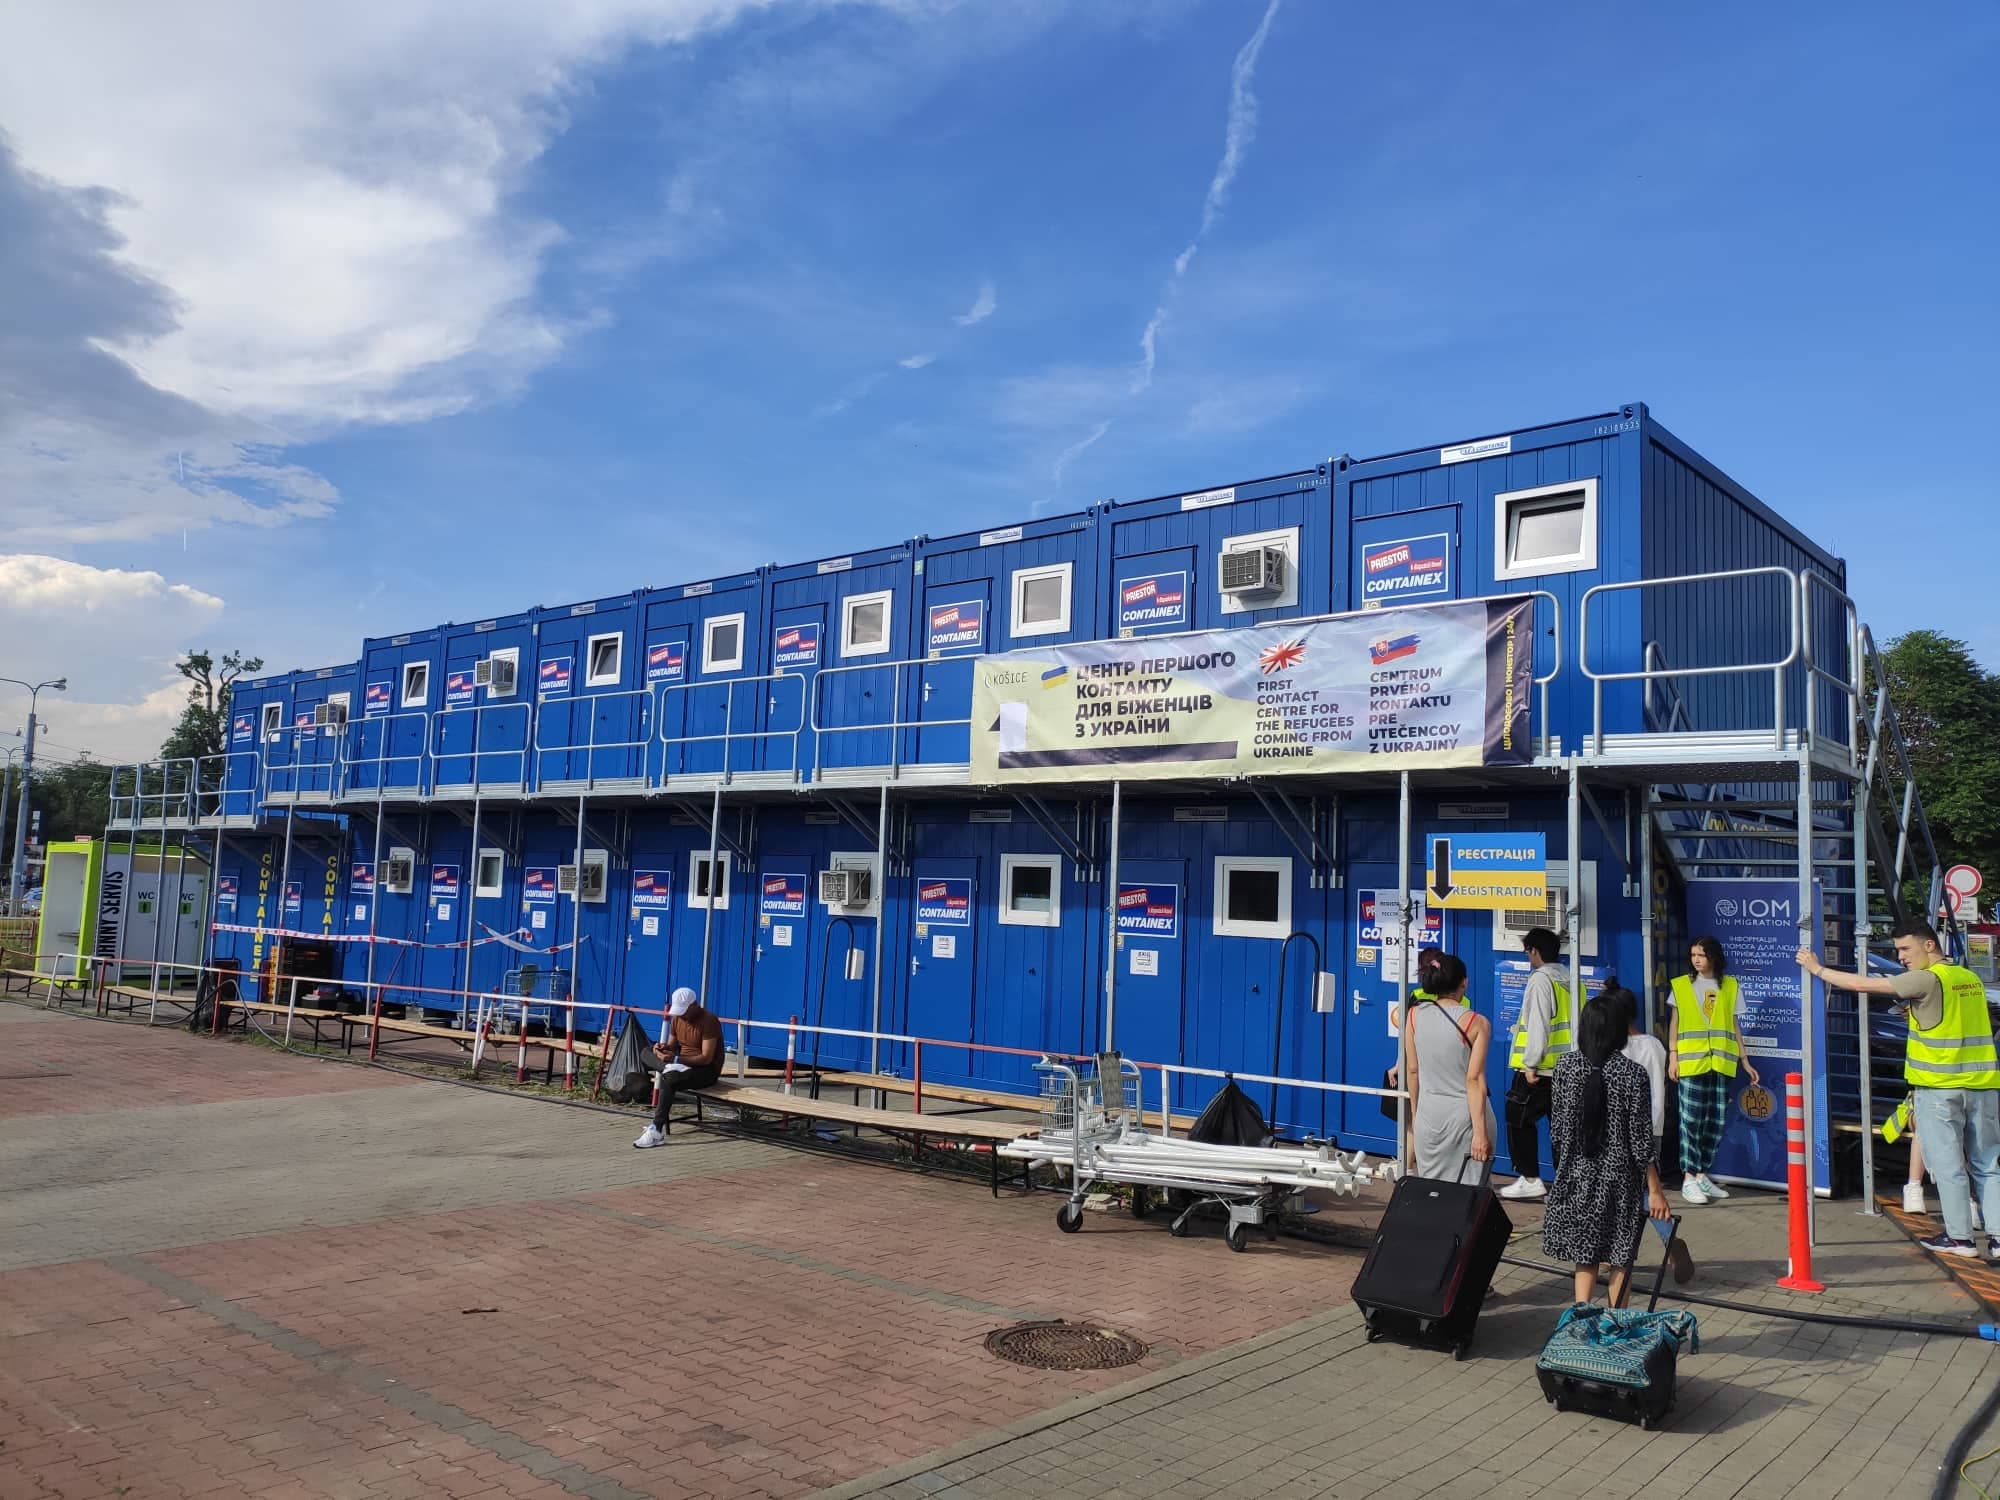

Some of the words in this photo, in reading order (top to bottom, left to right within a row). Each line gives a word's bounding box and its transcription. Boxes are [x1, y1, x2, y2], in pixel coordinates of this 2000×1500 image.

[1370, 549, 1409, 572] PRIESTOR
[1367, 571, 1443, 592] CONTAINEX
[1126, 584, 1156, 604] PRIESTOR
[1122, 605, 1181, 622] CONTAINEX
[931, 630, 979, 645] CONTAINEX
[776, 650, 816, 663] CONTAINEX
[1076, 662, 1140, 682] ЦЕНТР
[1141, 651, 1236, 675] ПЕРШОГО
[993, 672, 1028, 687] KOŠICE
[1370, 667, 1443, 683] CENTRUM
[1076, 677, 1173, 699] КОНТАКТУ
[1257, 680, 1294, 692] FIRST
[1370, 681, 1431, 698] PRVÉHO
[1257, 691, 1319, 706] CONTACT
[1370, 695, 1451, 712] KONTAKTU
[1075, 701, 1112, 721] ДЛЯ
[1116, 694, 1213, 716] БІЖЕНЦІВ
[1256, 705, 1308, 719] CENTRE
[1311, 703, 1339, 715] FOR
[1075, 723, 1085, 738] З
[1090, 716, 1170, 737] УКРАЇНИ
[1256, 720, 1280, 732] THE
[1283, 716, 1355, 730] REFUGEES
[1369, 713, 1398, 726] PRE
[1254, 732, 1309, 745] COMING
[1312, 730, 1353, 743] FROM
[1368, 724, 1461, 740] UTEČENCOV
[1253, 746, 1314, 759] UKRAINE
[1369, 743, 1379, 754] Z
[1383, 739, 1459, 754] UKRAJINY
[1457, 848, 1536, 861] РЕЄСТРАЦІЯ
[102, 871, 124, 915] SERVIS
[138, 891, 155, 900] WC
[322, 856, 337, 935] CONTAI
[1452, 886, 1543, 897] REGISTRATION
[634, 895, 667, 905] CONTAINEX
[763, 900, 803, 911] CONTAINEX
[1119, 893, 1147, 906] RIESTOR
[920, 907, 968, 919] CONTAINEX
[1743, 900, 1790, 917] IOM
[1734, 919, 1791, 927] MIGRATION
[1385, 936, 1415, 947] ВХД
[1741, 958, 1773, 966] УКРАЇНИ
[1769, 1008, 1799, 1016] POMOC
[1741, 1022, 1777, 1030] UKRAJINY
